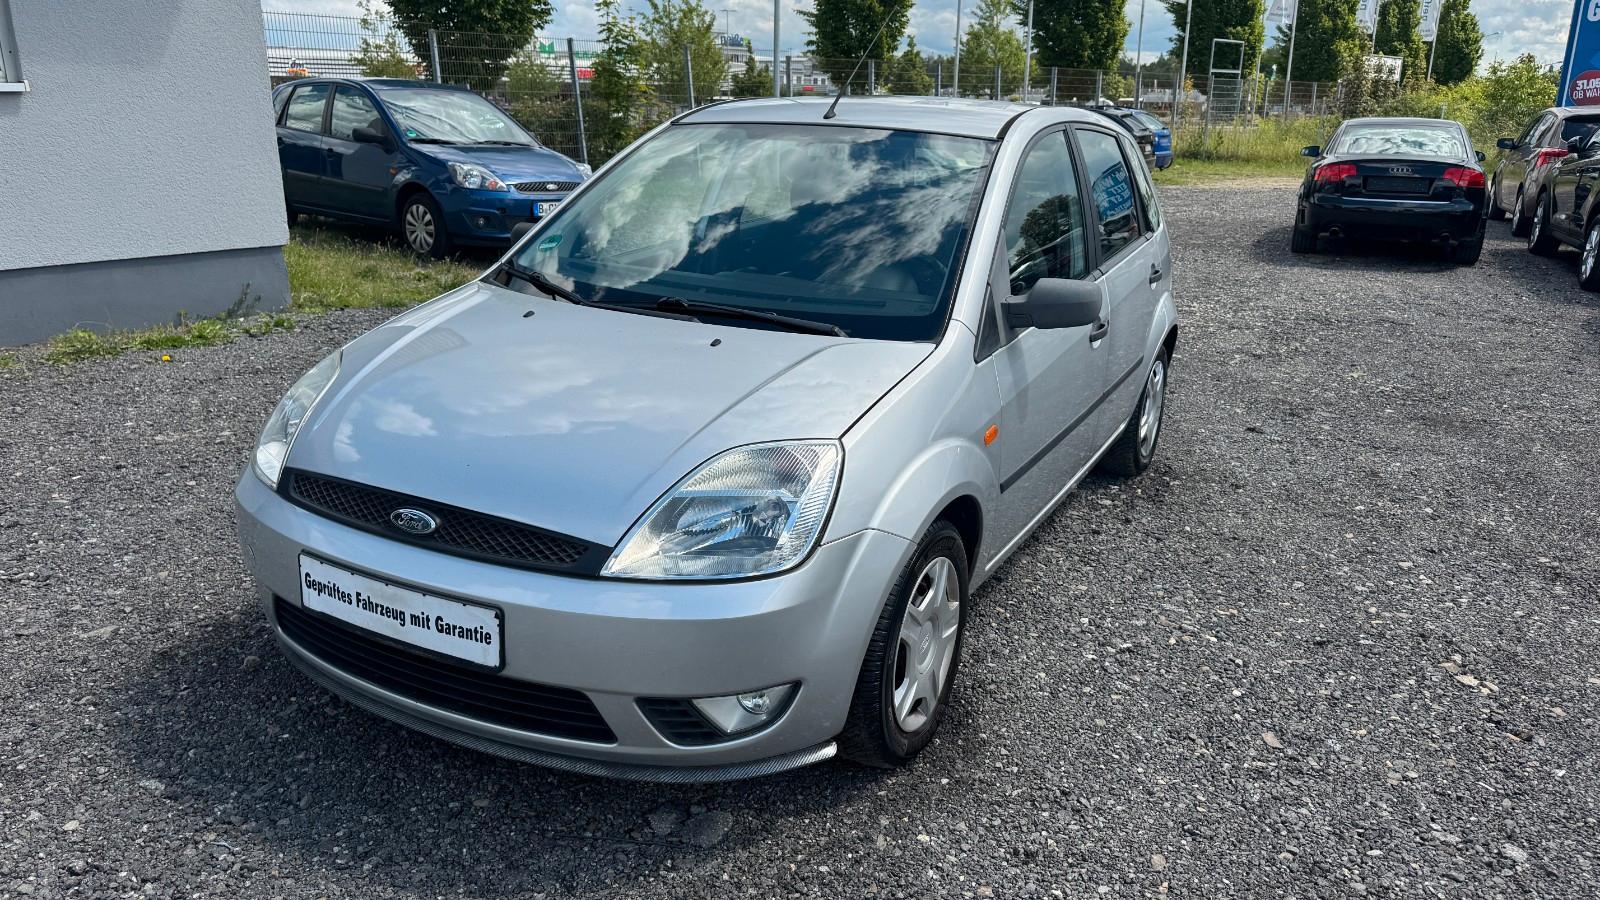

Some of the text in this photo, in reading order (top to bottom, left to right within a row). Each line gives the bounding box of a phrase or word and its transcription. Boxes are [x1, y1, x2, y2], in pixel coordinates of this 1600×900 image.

[1573, 90, 1584, 99] OB
[538, 203, 544, 213] B
[398, 512, 423, 529] Ford
[304, 571, 492, 645] Geprüftes Fahrzeug mit Garantie
